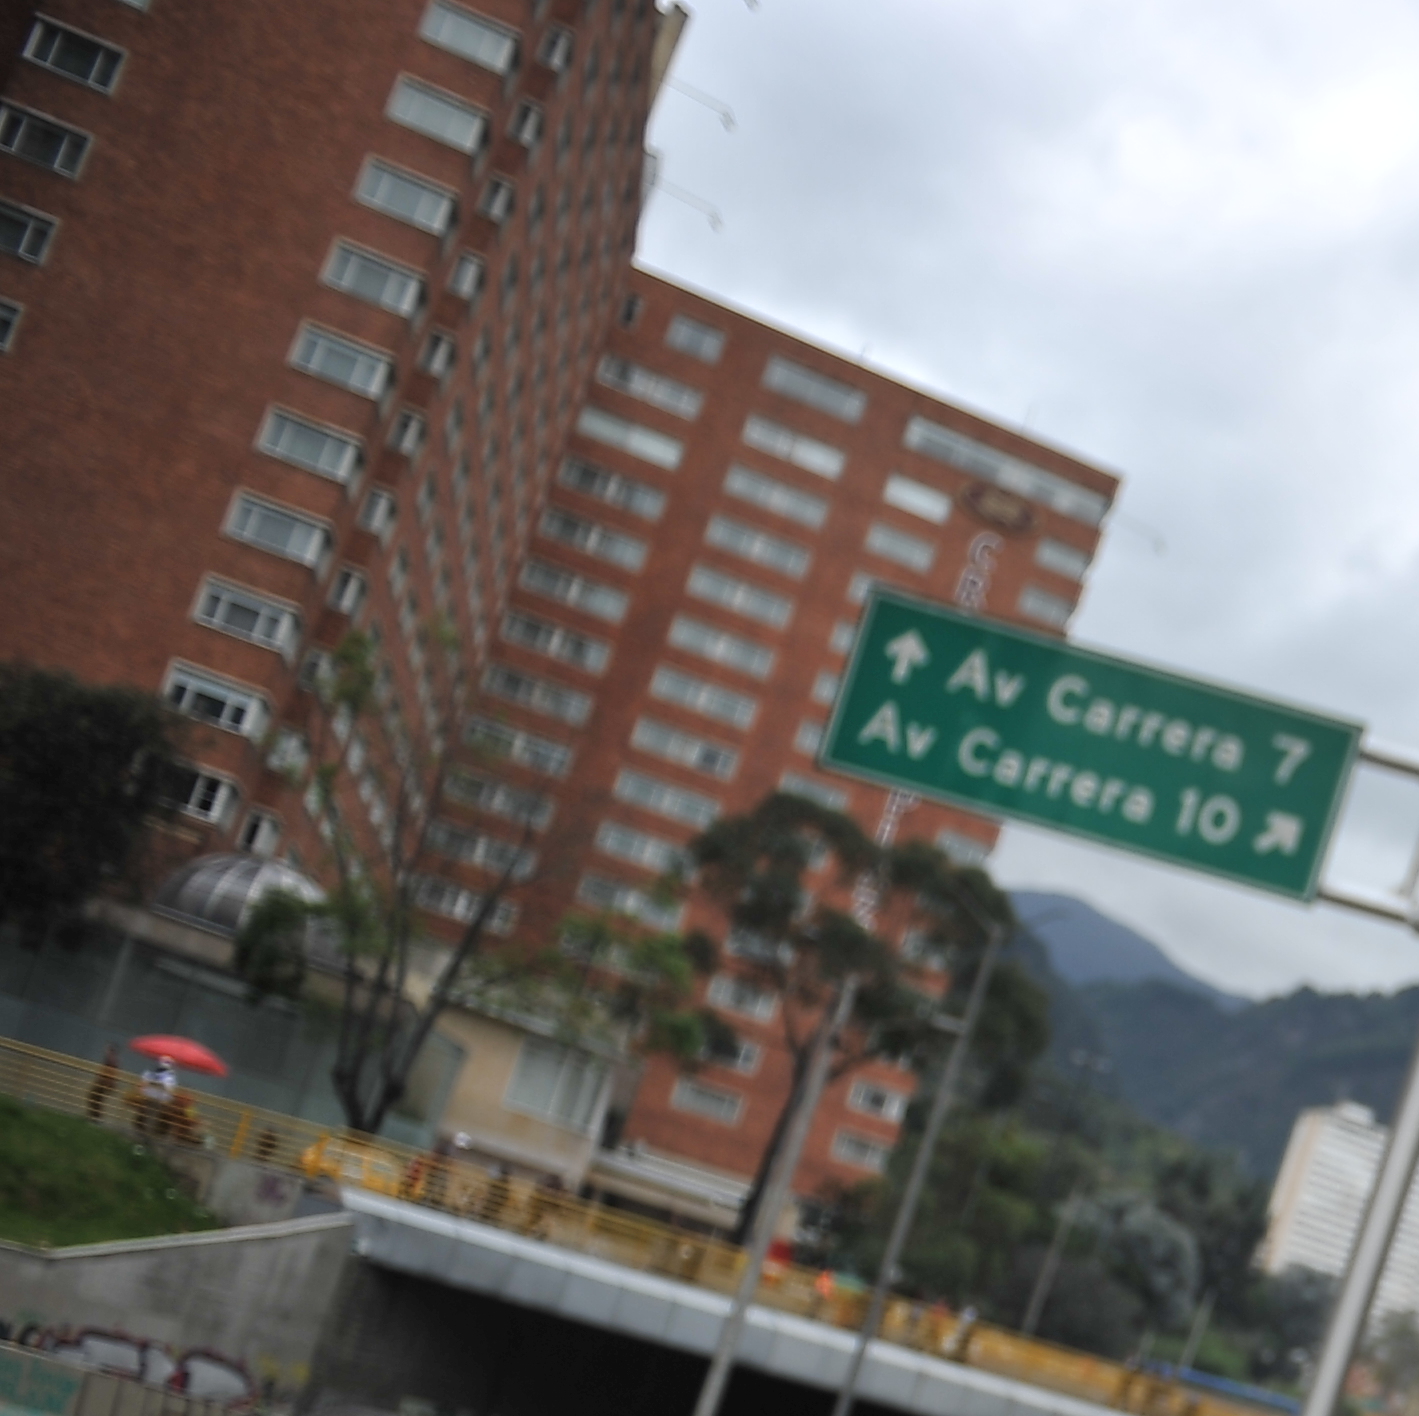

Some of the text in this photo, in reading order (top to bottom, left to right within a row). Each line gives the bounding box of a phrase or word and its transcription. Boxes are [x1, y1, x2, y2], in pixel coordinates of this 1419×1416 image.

[857, 702, 1241, 845] Av Carrera 10
[946, 648, 1312, 786] Av Carrera 7
